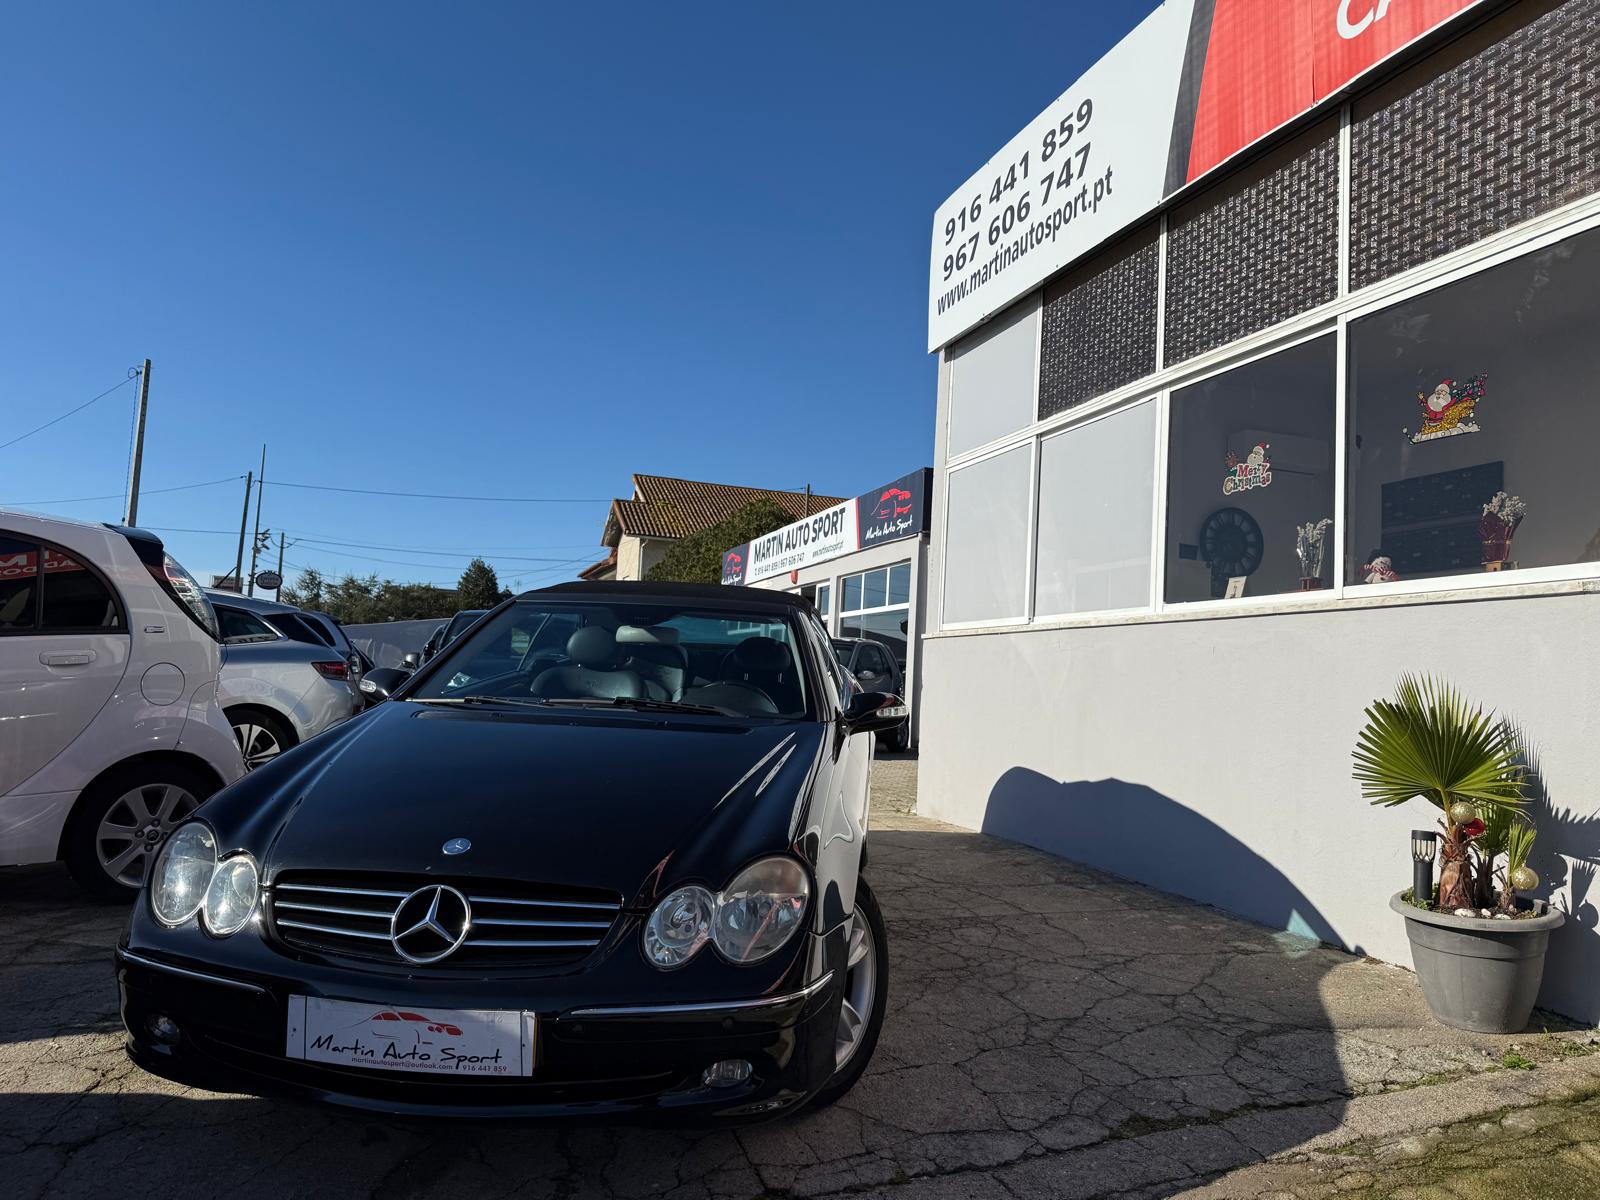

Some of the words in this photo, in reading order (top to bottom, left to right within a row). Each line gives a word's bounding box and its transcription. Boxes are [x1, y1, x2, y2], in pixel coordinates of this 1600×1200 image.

[945, 194, 982, 246] 916
[989, 150, 1030, 205] 441
[1041, 98, 1093, 163] 859
[943, 231, 980, 282] 967
[988, 190, 1031, 246] 606
[1040, 141, 1091, 207] 747
[937, 164, 1113, 316] www.martinautosport.pt
[1223, 472, 1272, 495] Christmas
[1237, 463, 1270, 478] Merry
[754, 533, 784, 564] MARTIN
[784, 522, 810, 551] AUTO
[811, 507, 846, 543] SPORT
[865, 526, 882, 540] Martin
[882, 522, 896, 535] Auto
[896, 515, 913, 534] Sport
[310, 1034, 375, 1058] Martin
[383, 1041, 431, 1060] Auto
[440, 1047, 503, 1070] Sport
[351, 1057, 453, 1070] martinautosport@outlook.com
